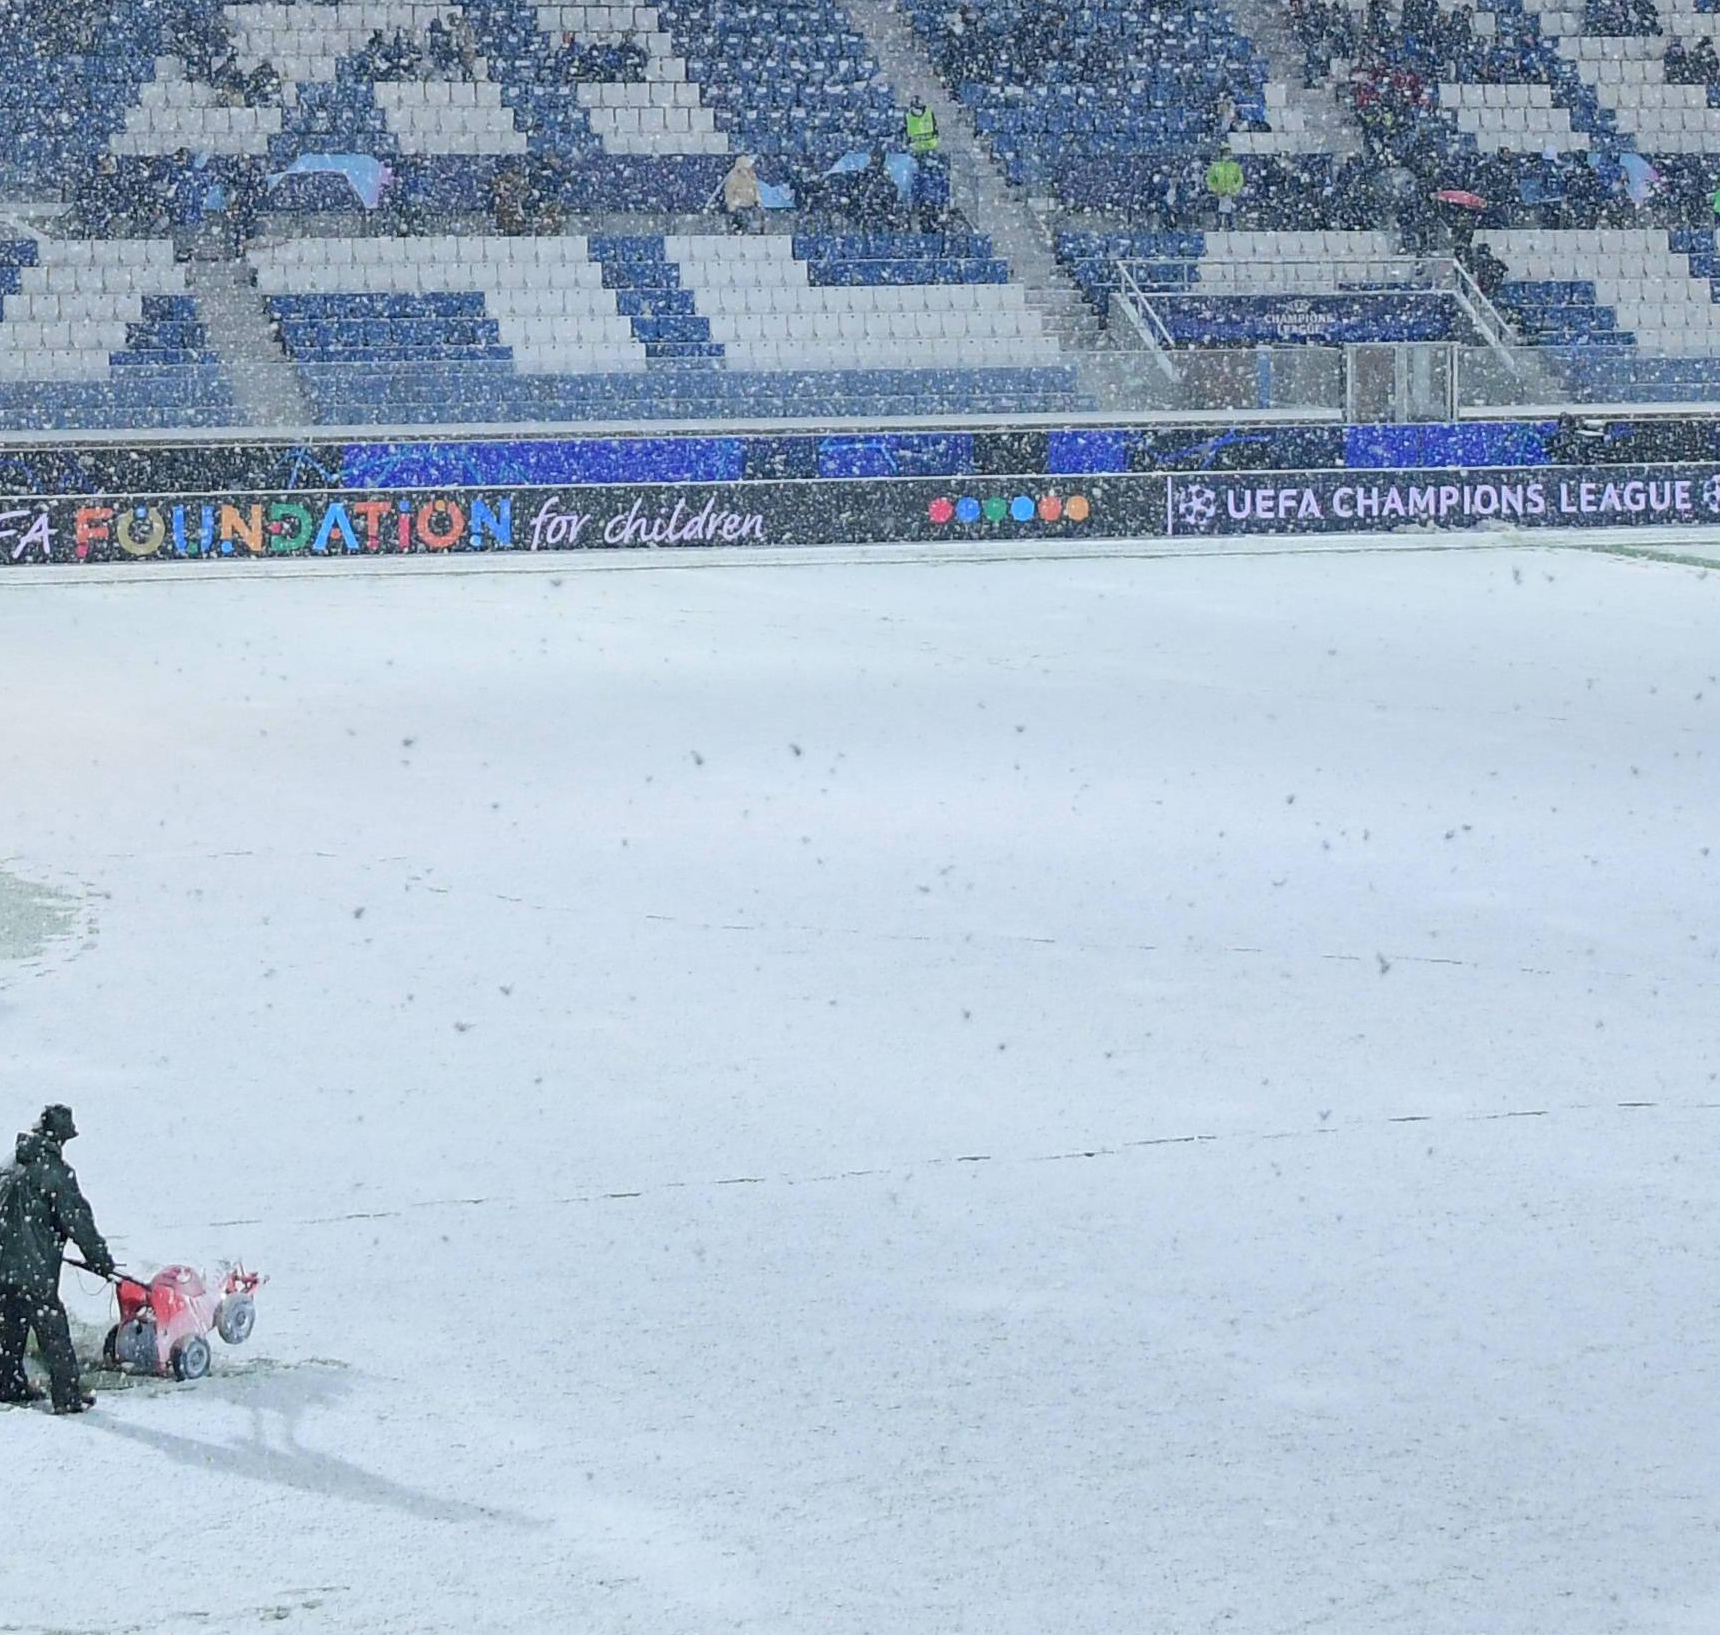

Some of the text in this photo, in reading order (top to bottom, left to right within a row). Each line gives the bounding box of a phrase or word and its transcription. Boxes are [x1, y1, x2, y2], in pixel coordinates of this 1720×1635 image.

[1226, 479, 1692, 520] UEFA CHAMPIONS LEAGUE
[74, 497, 512, 558] FOUNDATION
[529, 496, 592, 550] for
[603, 495, 765, 544] children
